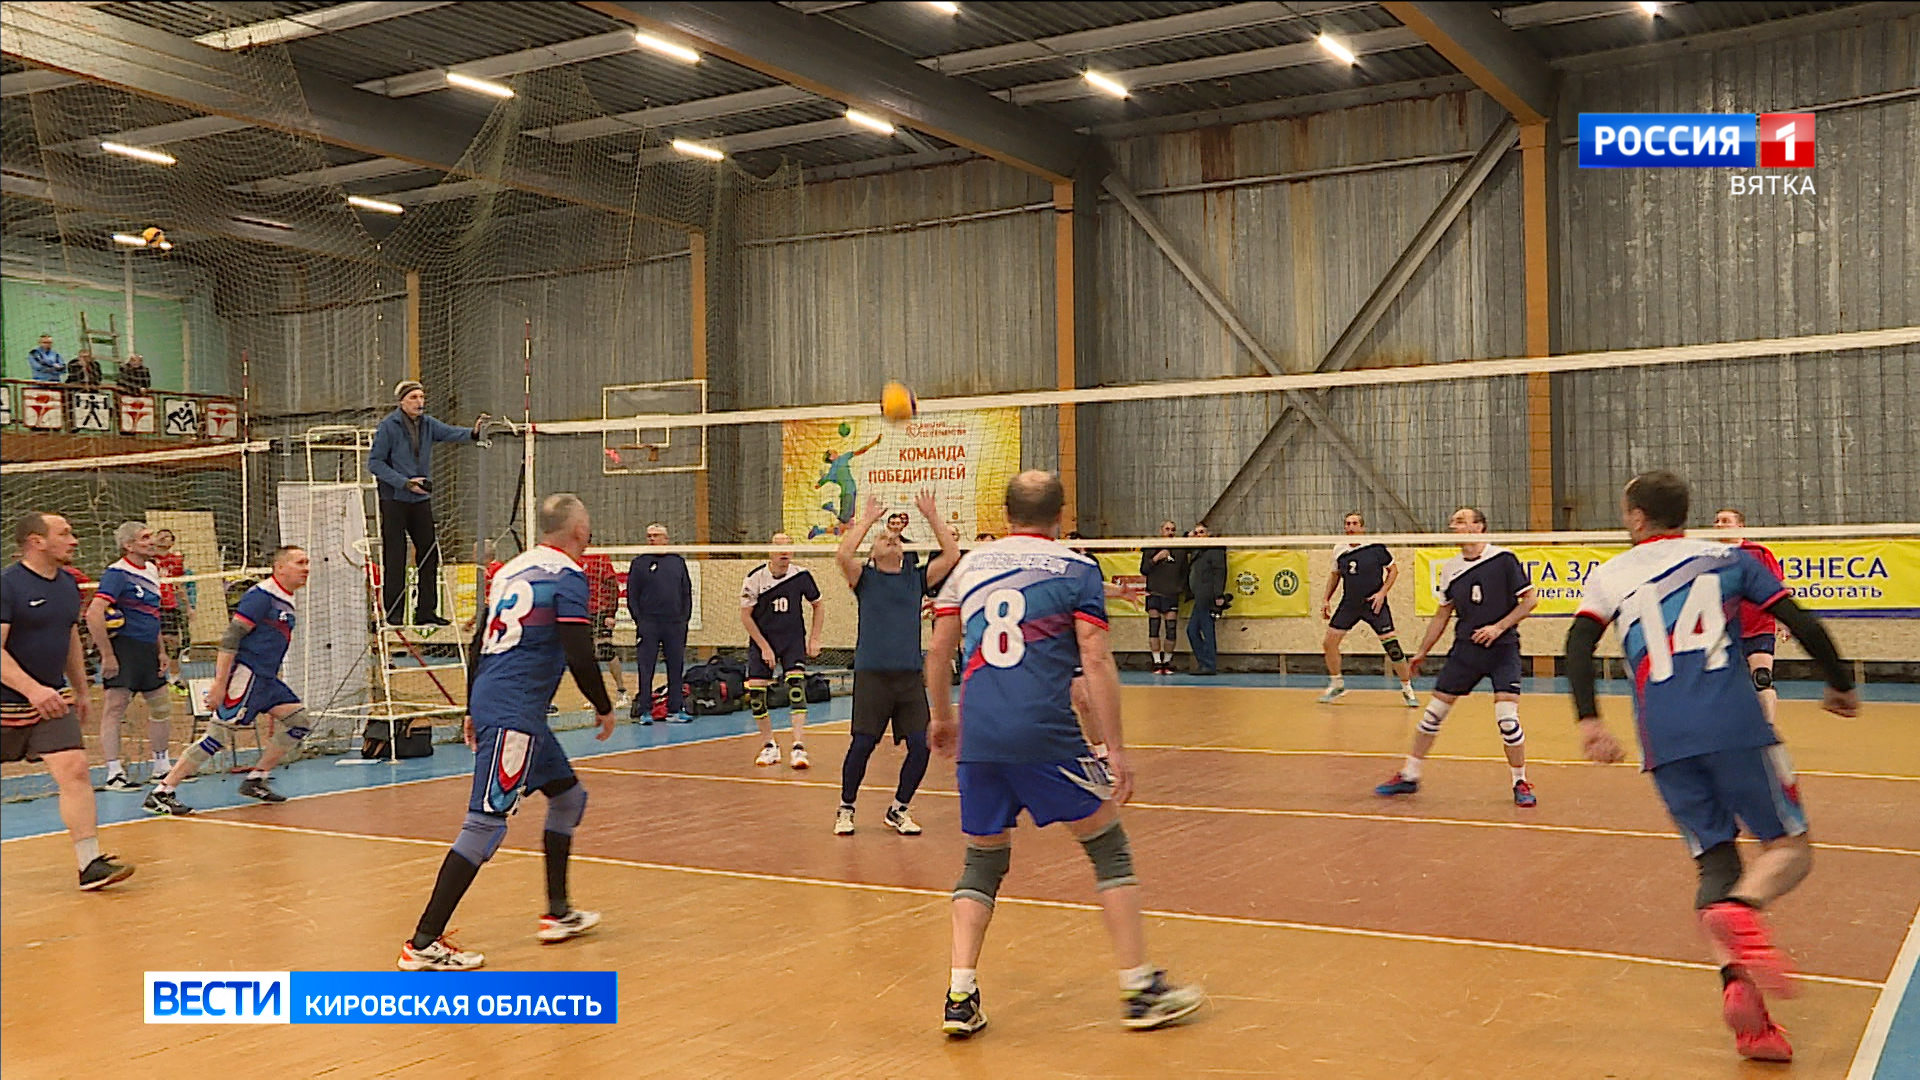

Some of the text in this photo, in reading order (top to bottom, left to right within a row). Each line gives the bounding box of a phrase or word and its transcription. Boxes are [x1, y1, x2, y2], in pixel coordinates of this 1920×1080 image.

[899, 445, 966, 461] КОМАНДА
[868, 463, 966, 483] ПОБЕДИТЕЛЕЙ
[771, 597, 789, 612] 10
[981, 588, 1026, 669] 8
[1620, 573, 1732, 682] 14
